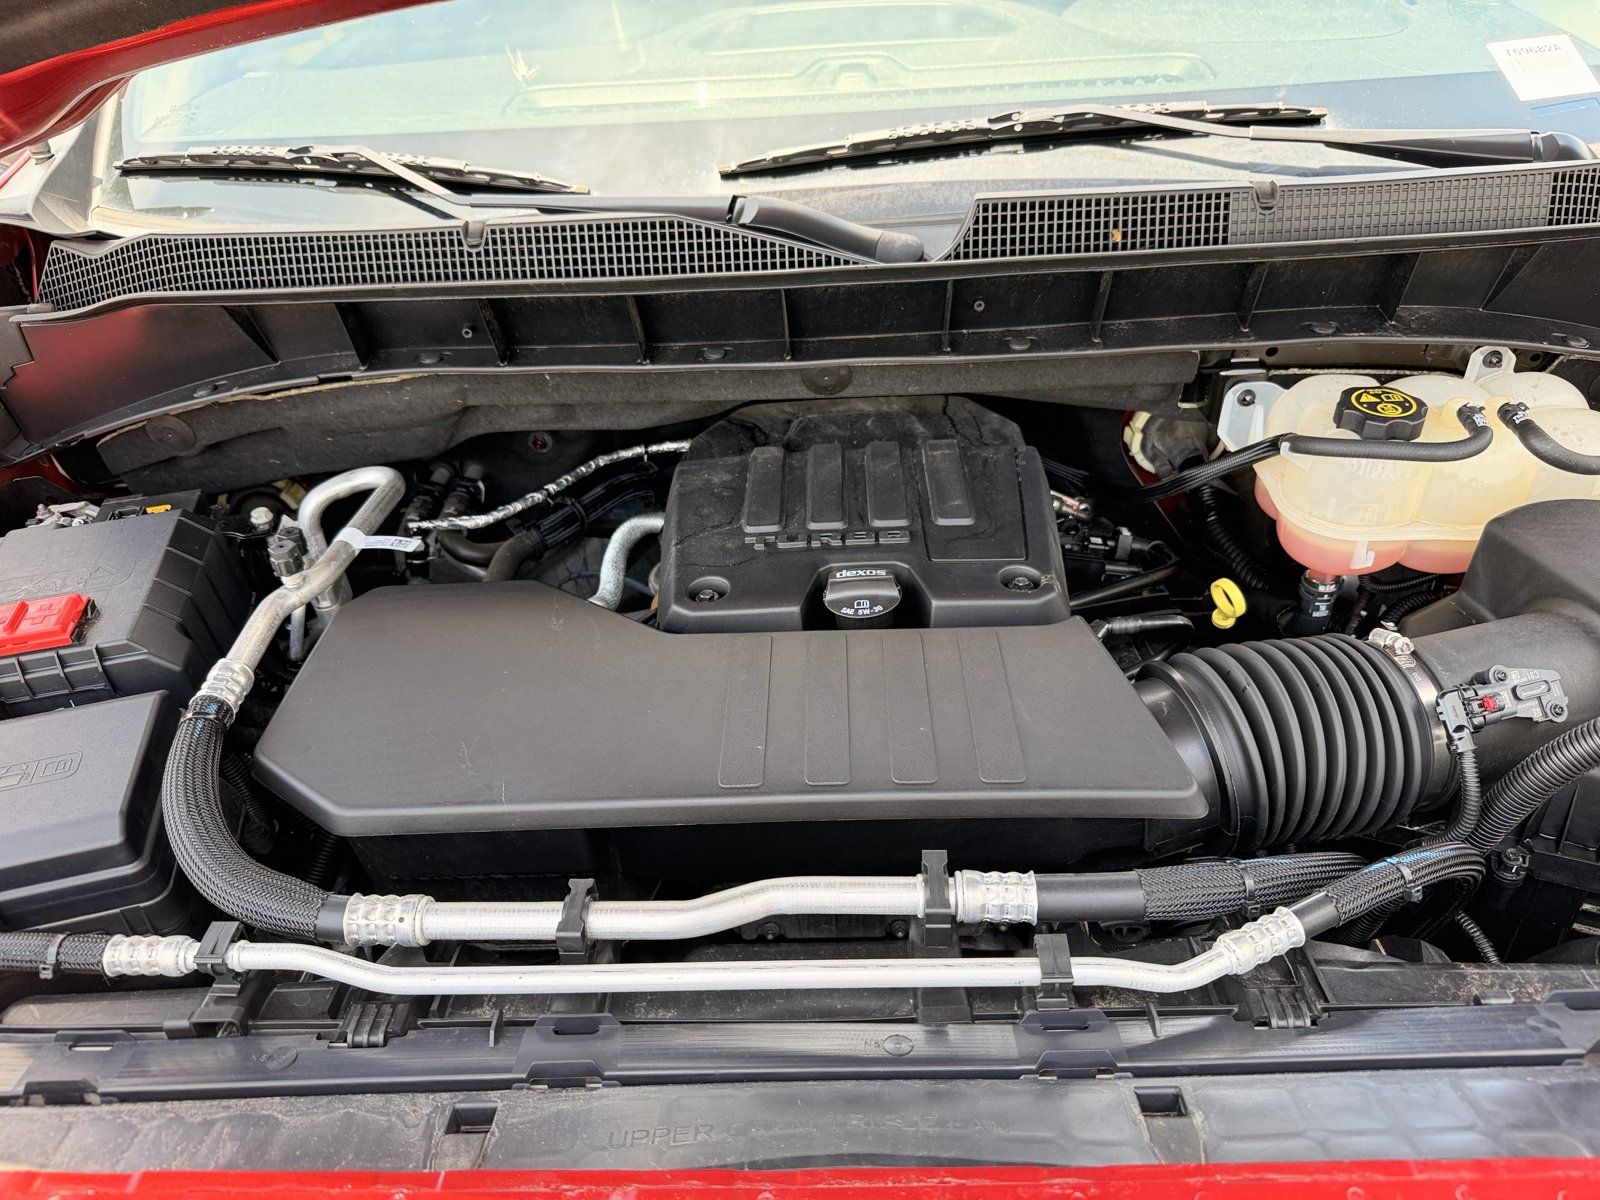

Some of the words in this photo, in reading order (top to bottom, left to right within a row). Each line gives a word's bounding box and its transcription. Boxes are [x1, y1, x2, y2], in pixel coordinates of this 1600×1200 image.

[744, 530, 911, 550] TURBO
[836, 569, 887, 578] dexos
[841, 606, 855, 615] SAE
[857, 605, 884, 615] 5W-30
[607, 1123, 714, 1150] UPPER
